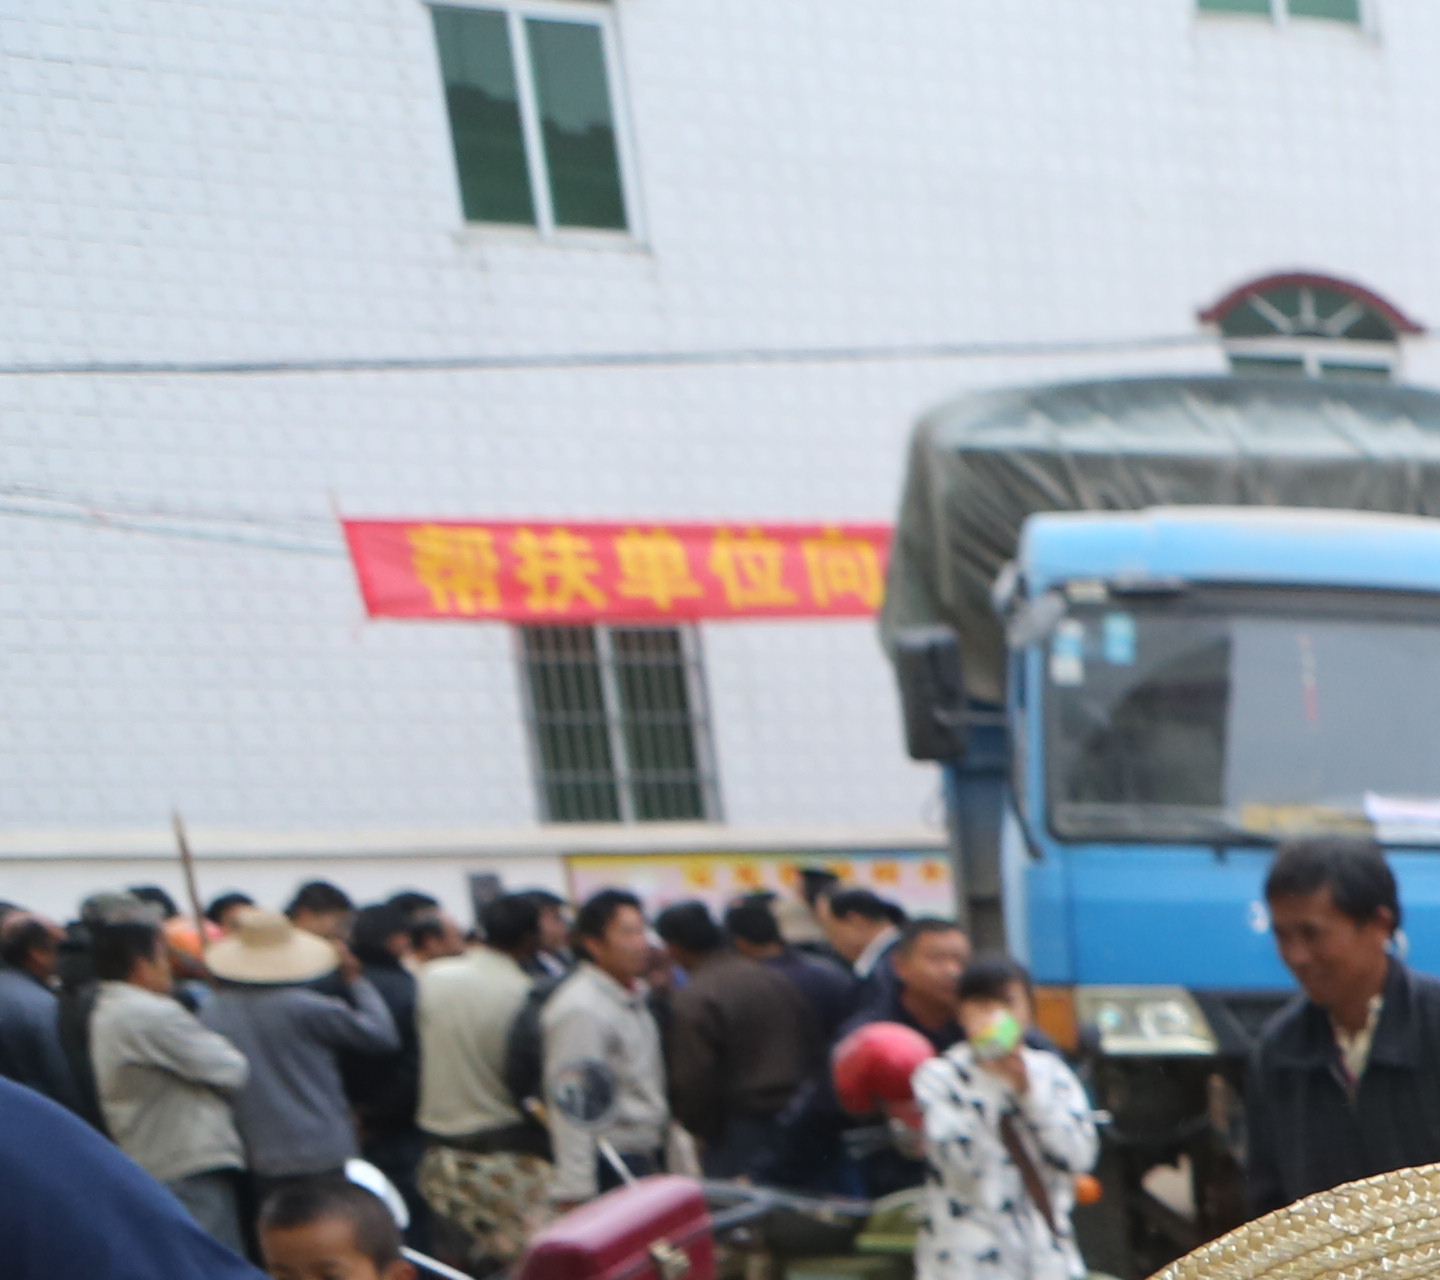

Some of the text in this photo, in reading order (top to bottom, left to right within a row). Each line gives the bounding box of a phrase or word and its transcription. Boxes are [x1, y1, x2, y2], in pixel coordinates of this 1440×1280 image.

[407, 522, 886, 615] 帮扶单位向
